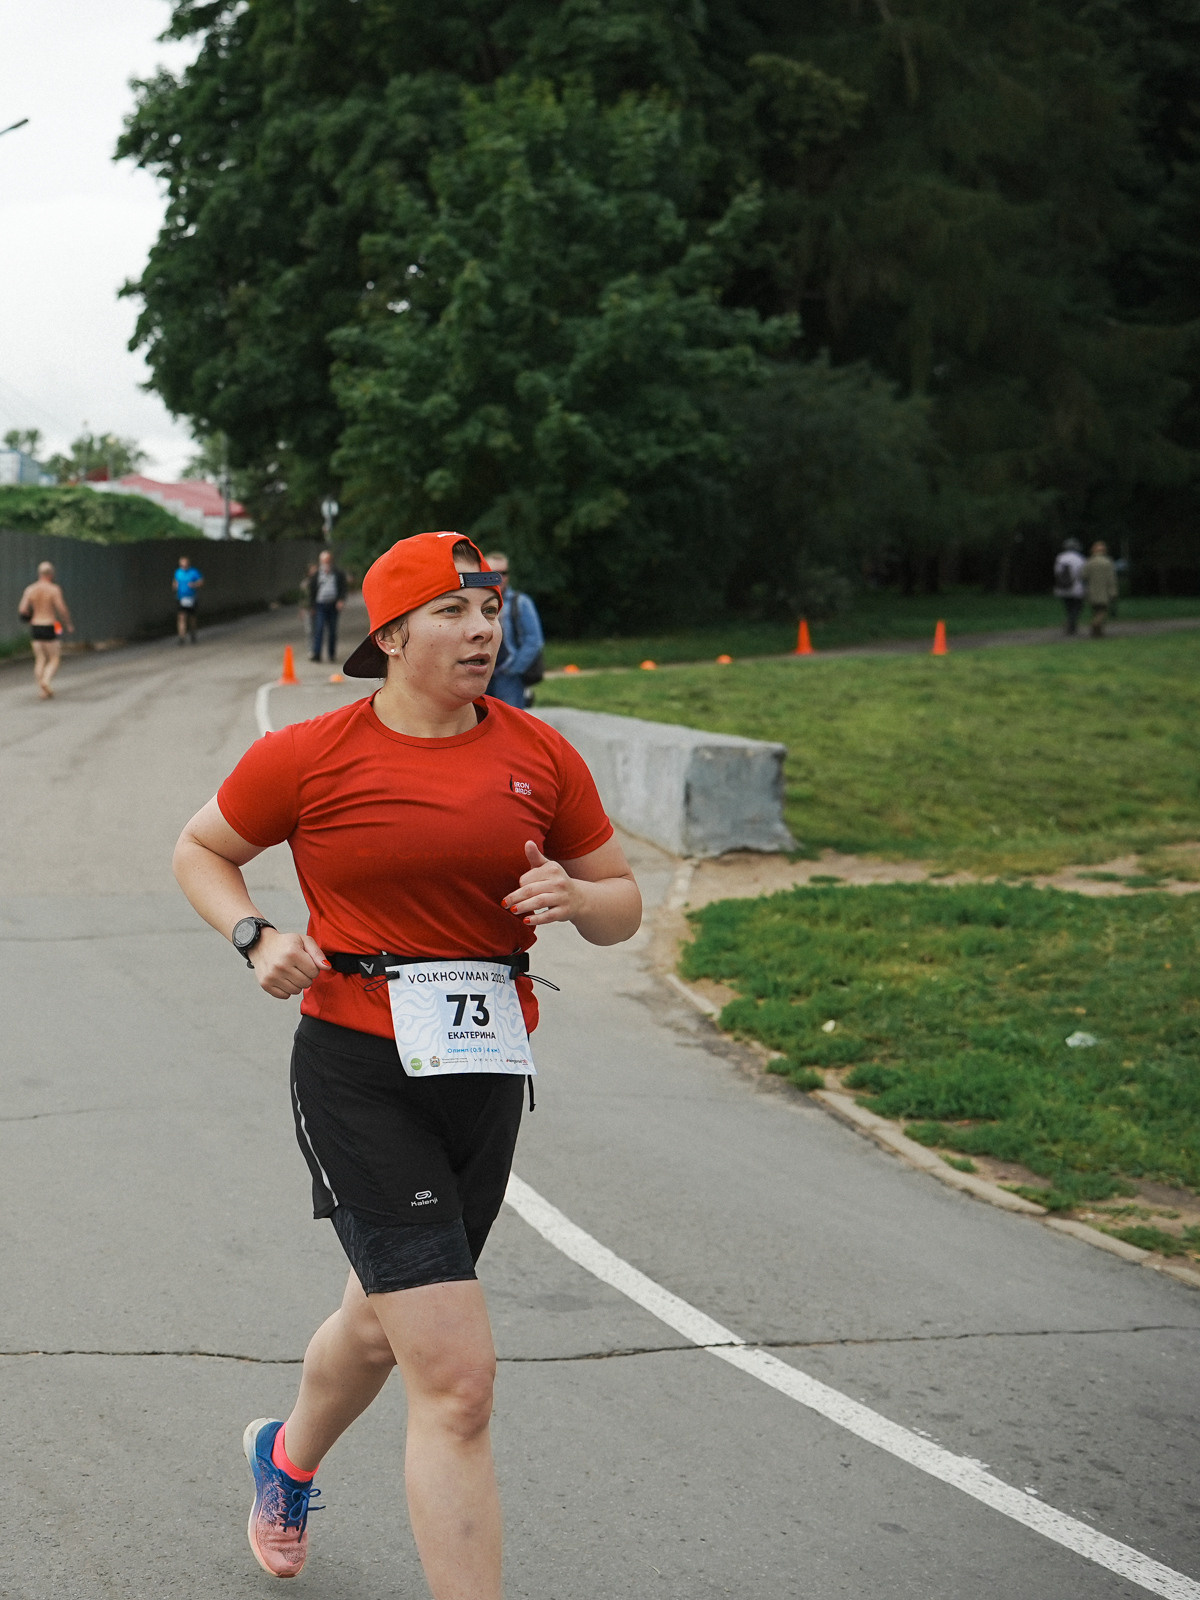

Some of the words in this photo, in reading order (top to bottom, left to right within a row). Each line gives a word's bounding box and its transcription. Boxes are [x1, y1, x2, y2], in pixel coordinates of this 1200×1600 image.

[514, 781, 529, 789] IRON
[408, 971, 489, 984] VOLKHOVMAN
[446, 994, 490, 1026] 73
[448, 1032, 496, 1040] ЕКАТЕРИНА
[411, 1197, 438, 1206] Kalenji
